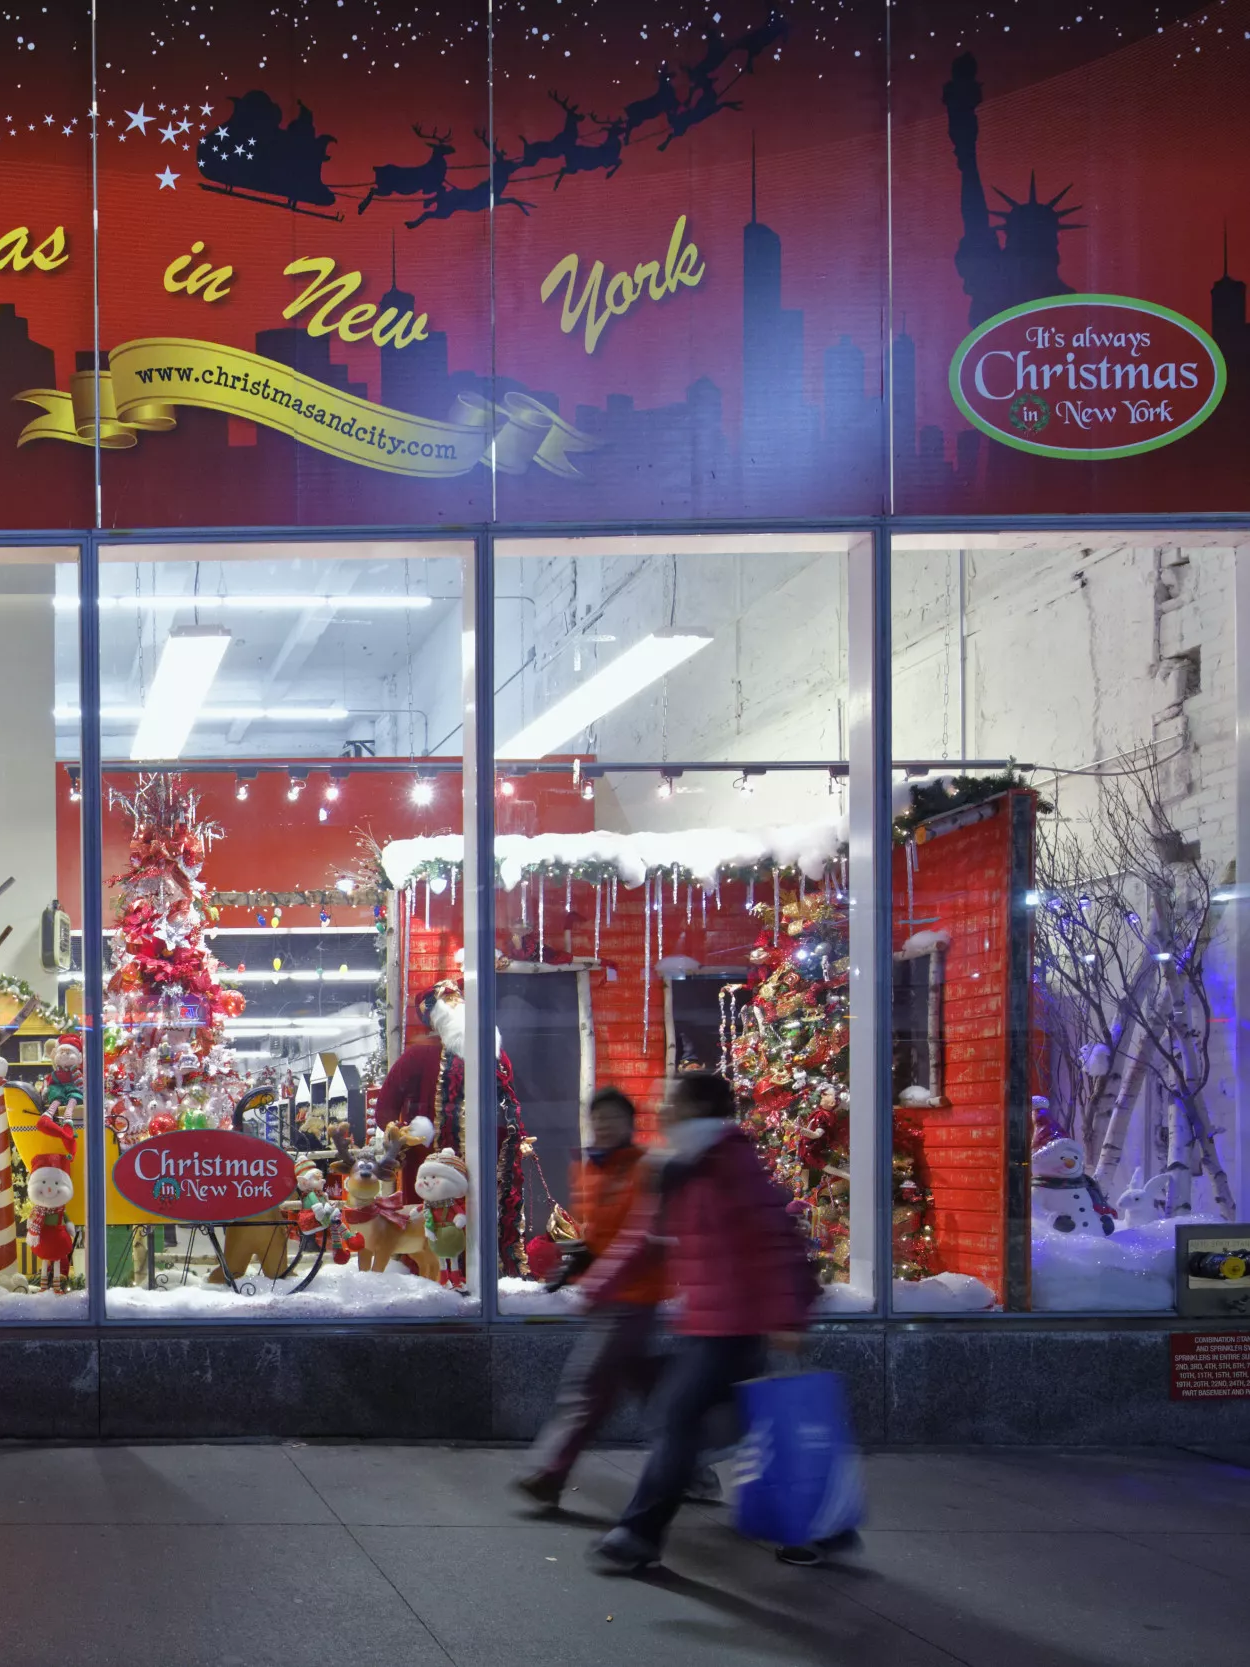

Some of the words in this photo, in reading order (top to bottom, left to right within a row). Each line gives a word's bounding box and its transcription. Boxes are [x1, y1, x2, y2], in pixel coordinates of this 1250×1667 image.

[163, 241, 233, 302] in
[283, 256, 429, 349] New
[540, 214, 706, 354] York
[1026, 327, 1064, 349] It's
[1072, 326, 1150, 357] always
[974, 350, 1199, 400] Christmas
[135, 364, 457, 461] www.christmasandcity.com
[1023, 406, 1038, 422] in
[1055, 401, 1117, 430] New
[1121, 400, 1174, 424] York
[134, 1149, 278, 1180] Christmas
[161, 1183, 174, 1195] in
[181, 1179, 227, 1201] New
[231, 1180, 273, 1198] York
